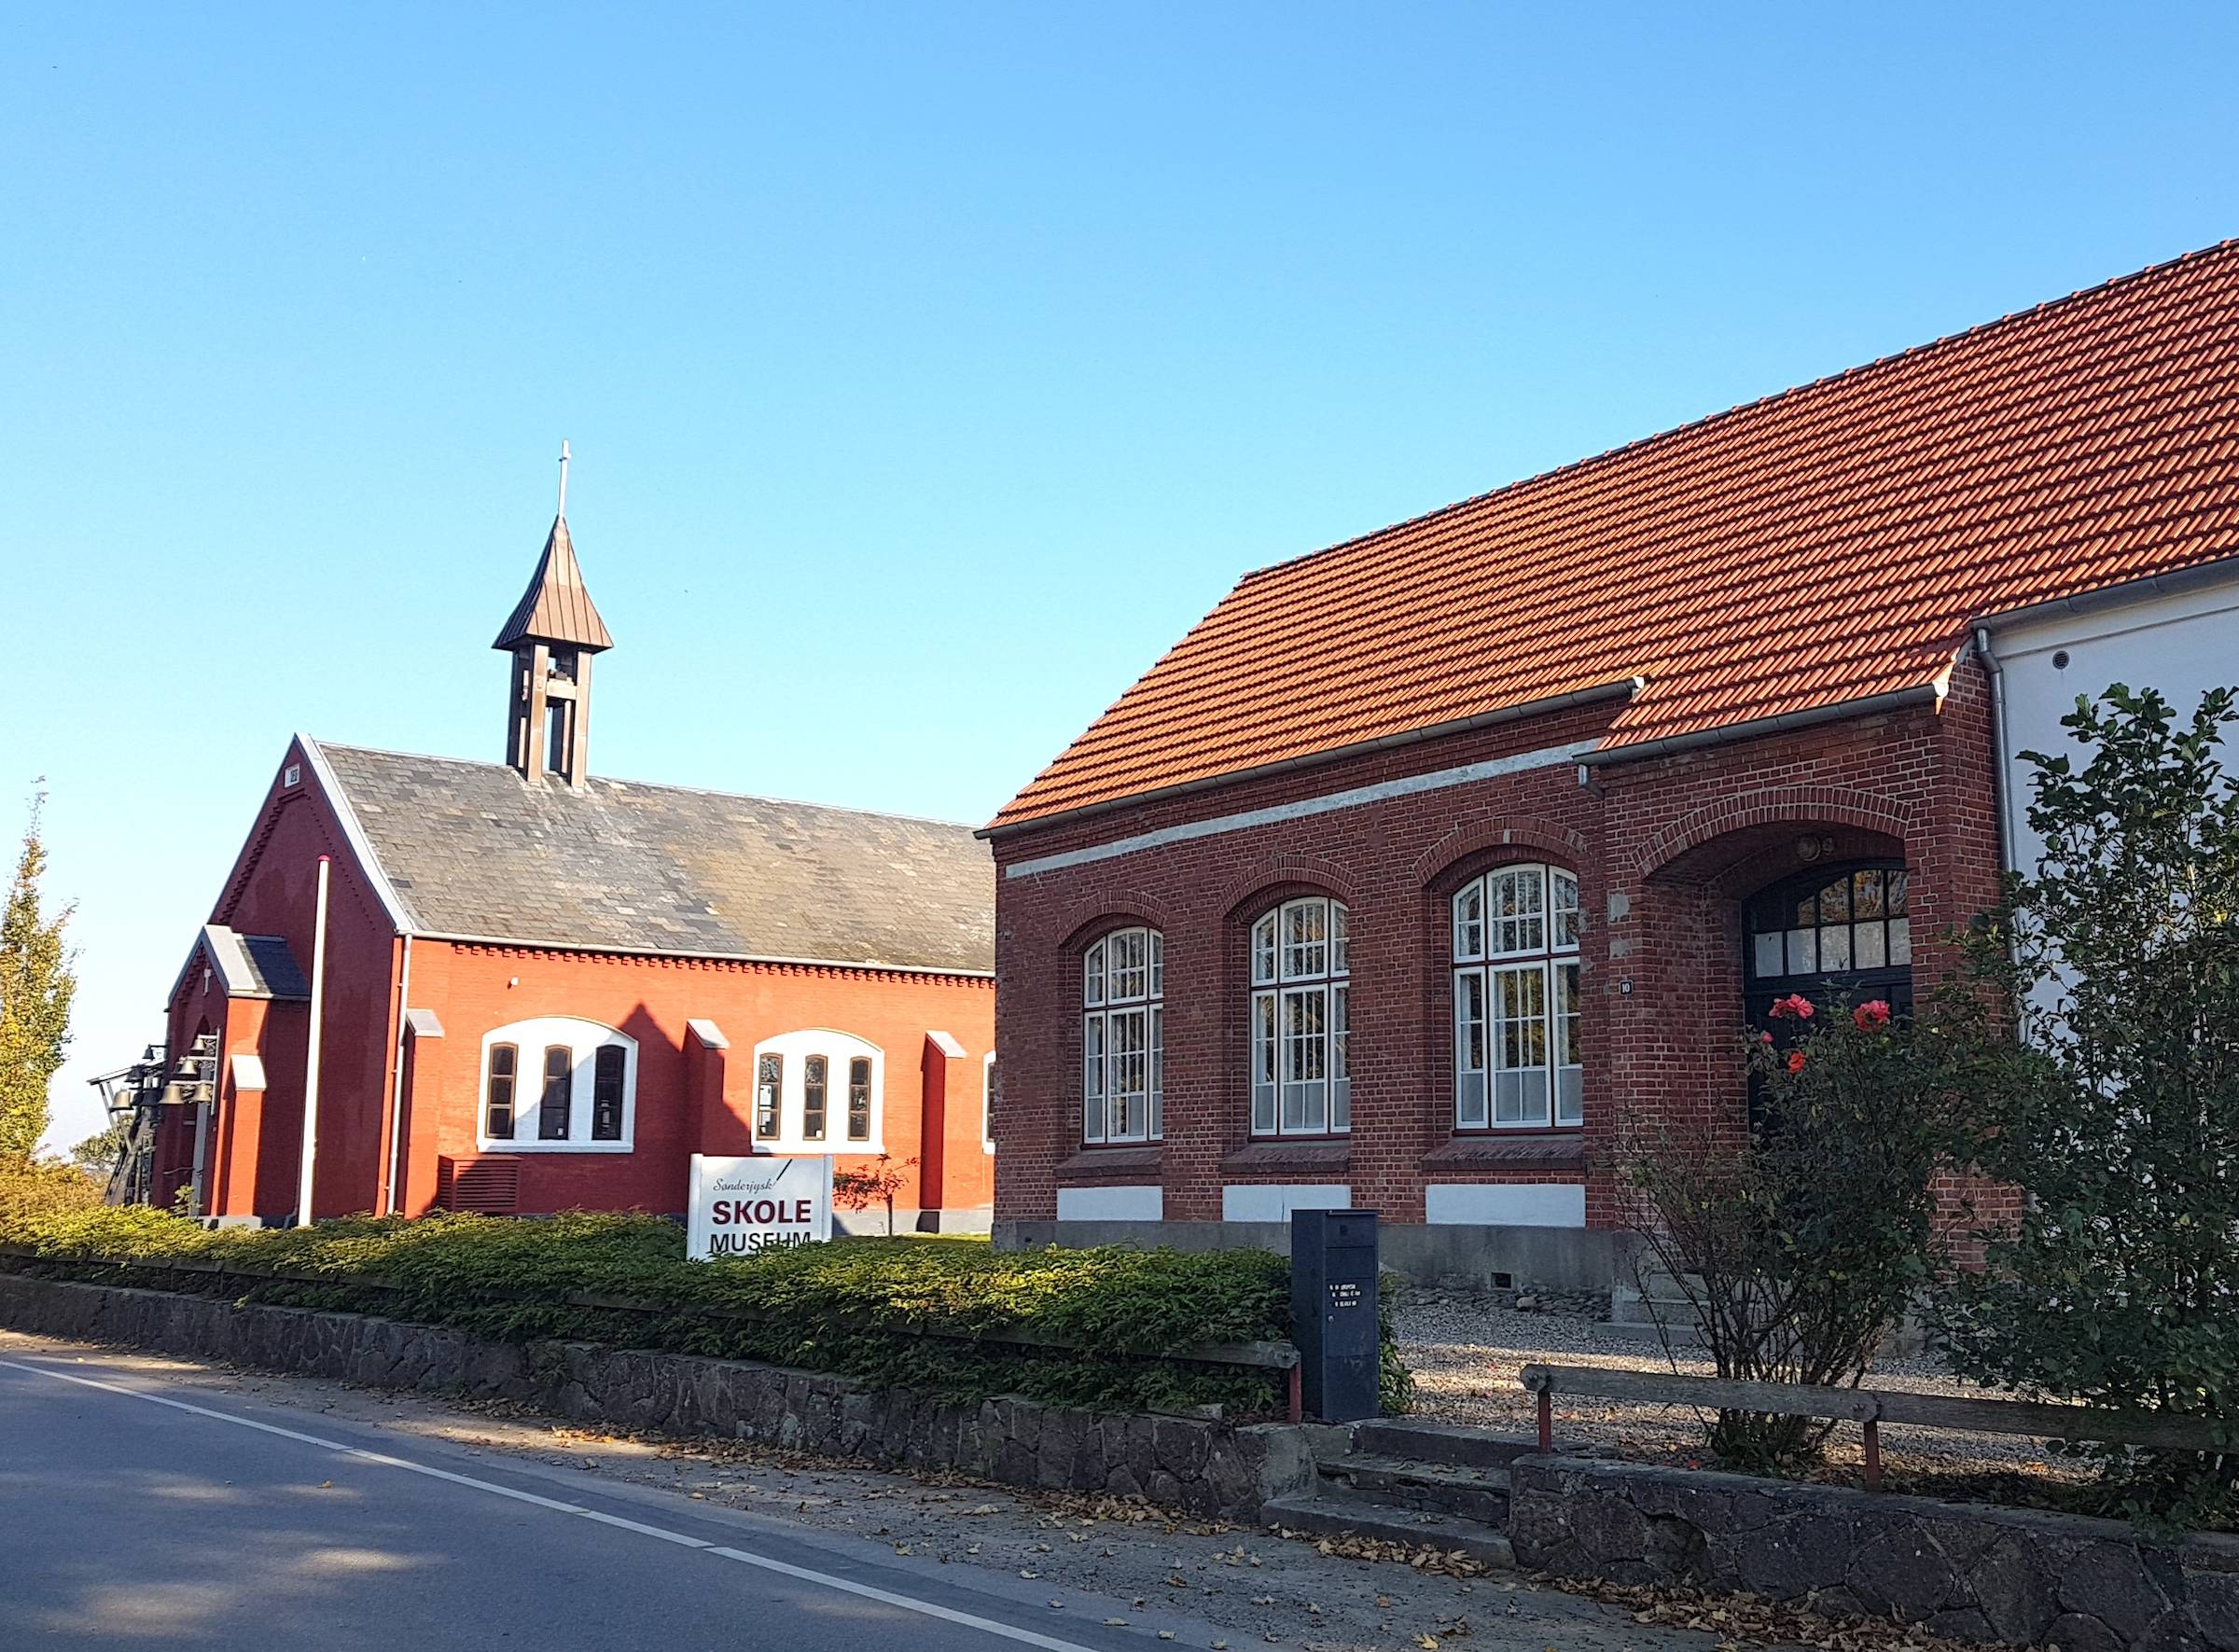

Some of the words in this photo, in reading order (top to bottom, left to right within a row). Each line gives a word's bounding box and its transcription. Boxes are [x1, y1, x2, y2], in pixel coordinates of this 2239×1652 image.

[1621, 982, 1630, 993] 10
[713, 1177, 772, 1195] Sønderjysk
[712, 1200, 812, 1225] SKOLE
